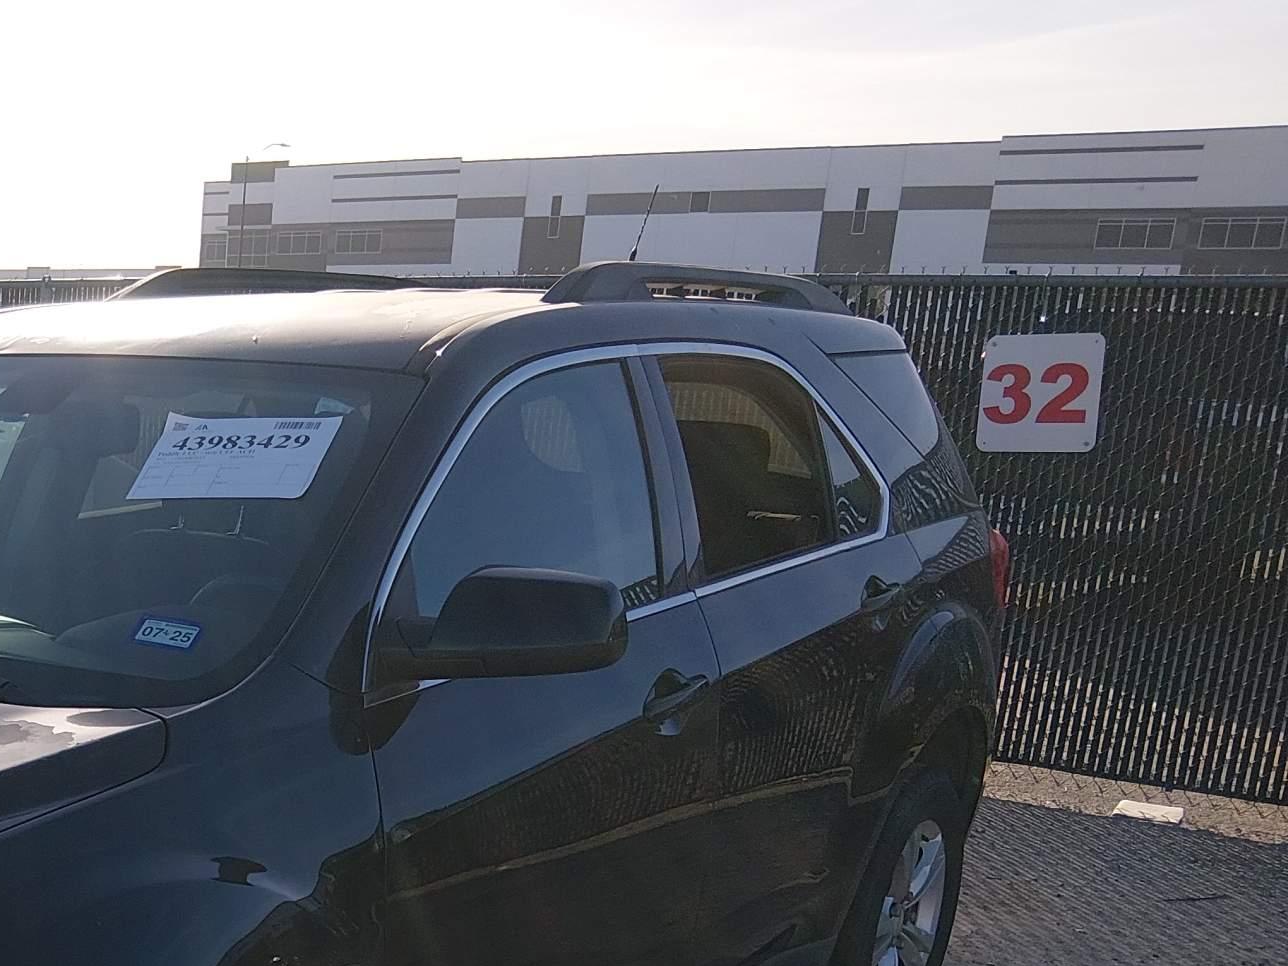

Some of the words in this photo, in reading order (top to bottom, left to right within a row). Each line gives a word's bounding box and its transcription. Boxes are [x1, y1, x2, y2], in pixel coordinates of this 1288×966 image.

[982, 362, 1090, 425] 32
[172, 434, 311, 451] 43983429
[141, 626, 165, 639] 07
[168, 630, 193, 643] 25
